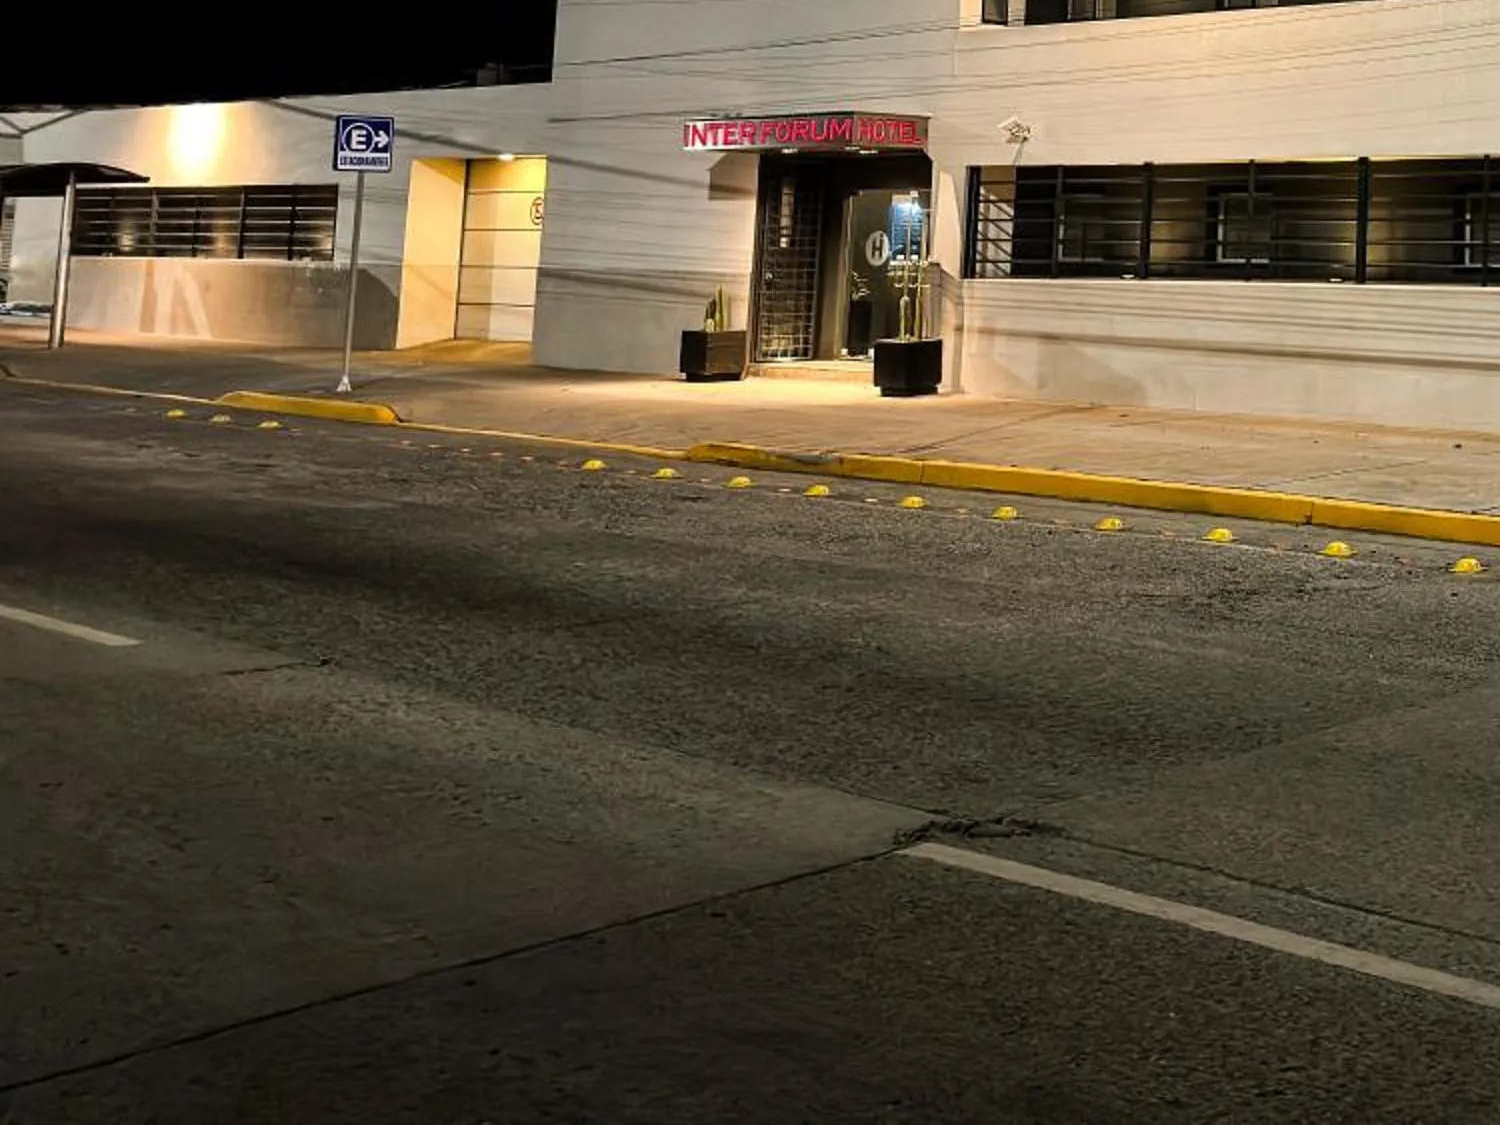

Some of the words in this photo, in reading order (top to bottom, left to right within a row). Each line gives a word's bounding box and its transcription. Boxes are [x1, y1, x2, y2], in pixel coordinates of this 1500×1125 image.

[351, 129, 367, 150] E
[683, 122, 756, 147] INTER
[759, 118, 853, 145] FORUM
[857, 118, 925, 145] HOTEL
